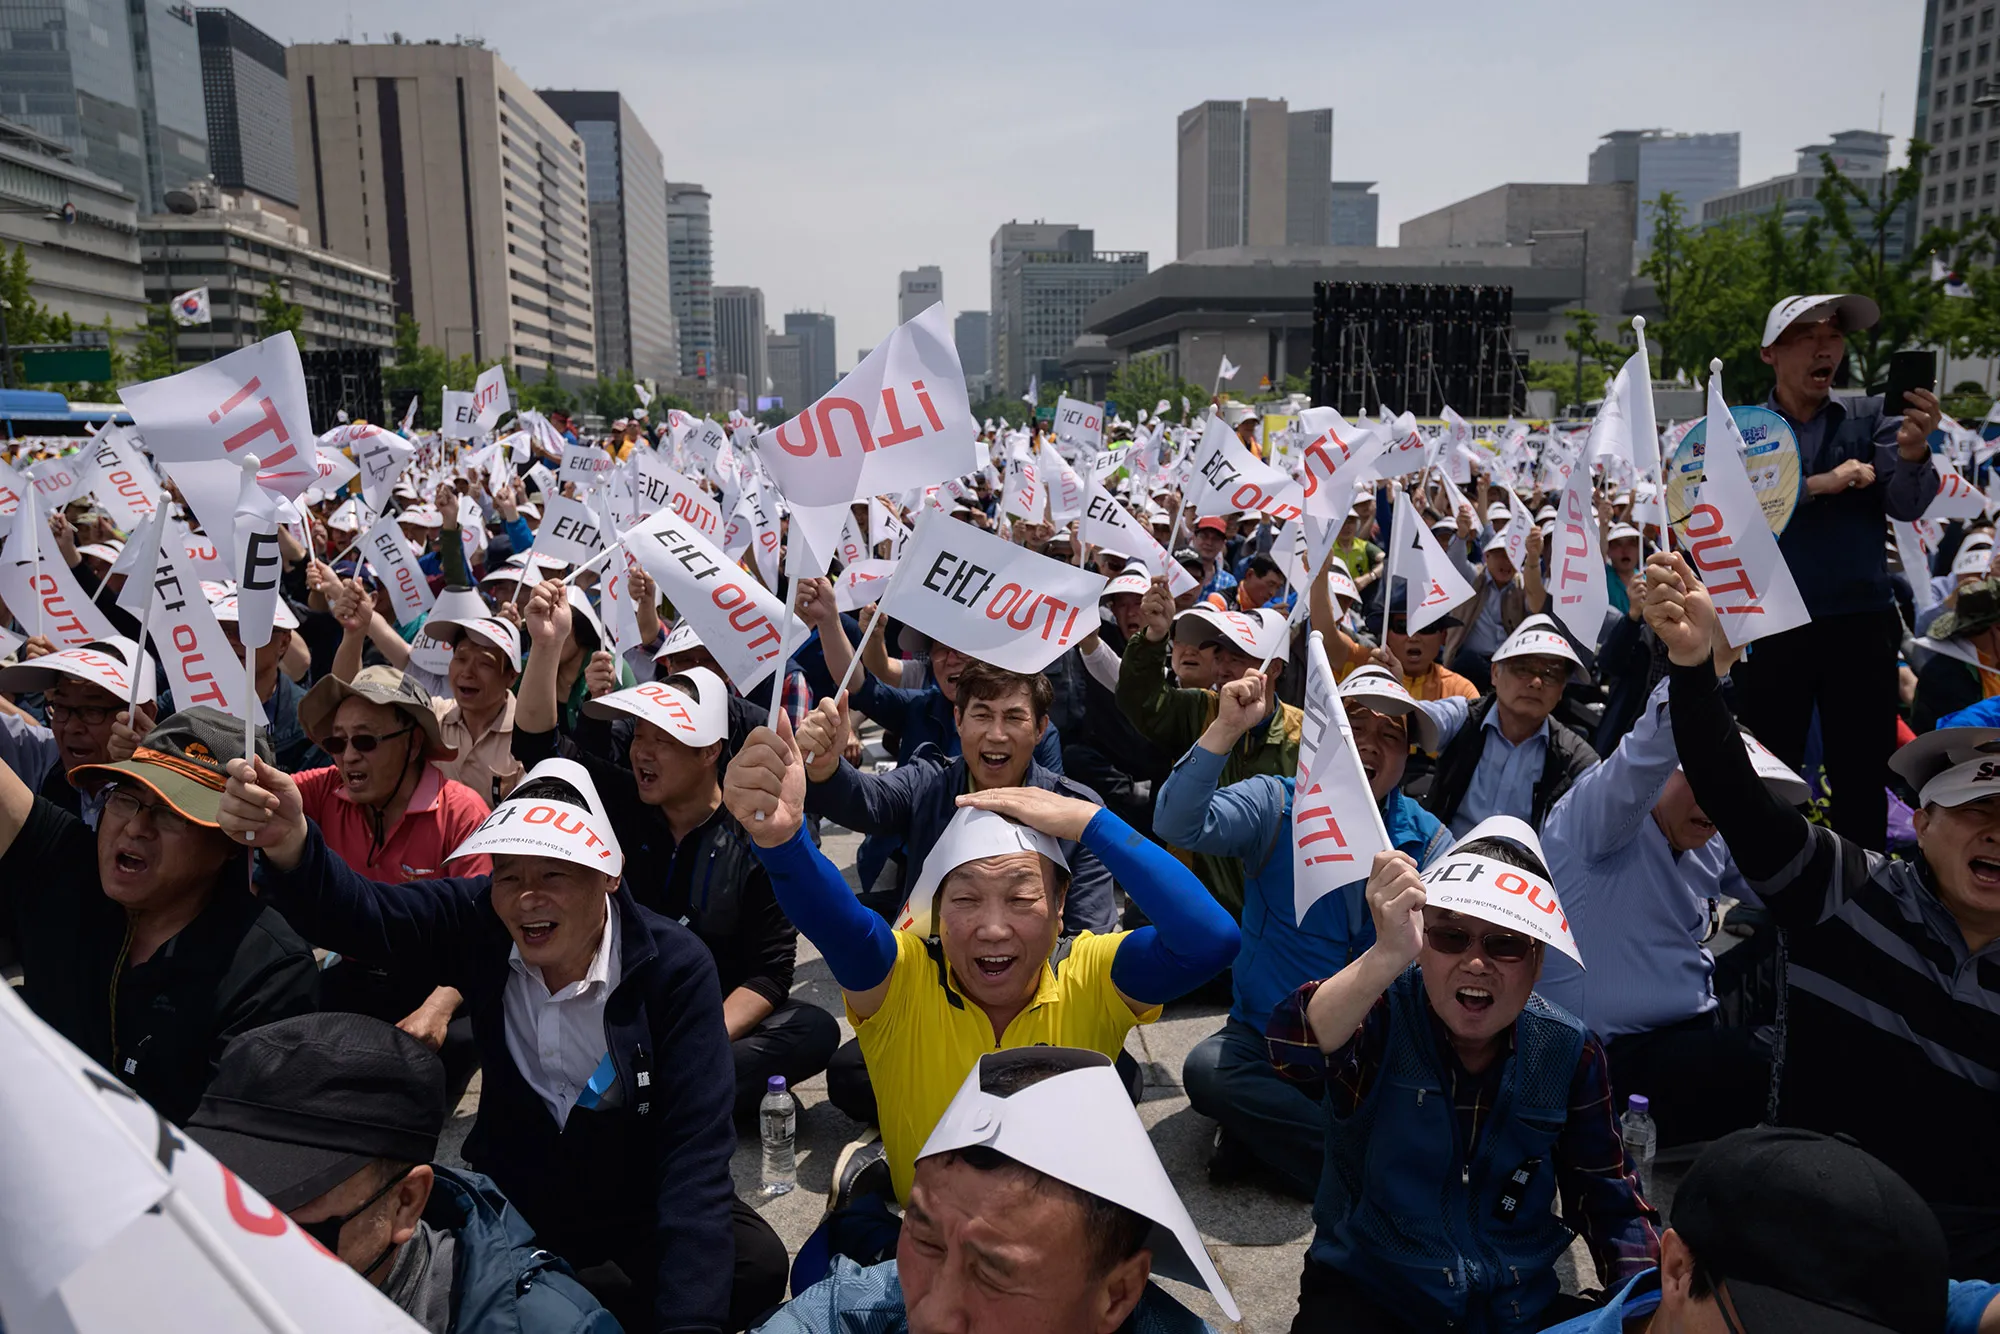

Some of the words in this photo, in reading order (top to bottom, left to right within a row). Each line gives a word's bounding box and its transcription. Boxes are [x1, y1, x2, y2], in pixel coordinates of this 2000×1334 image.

[1084, 416, 1100, 431] OU
[109, 471, 156, 513] OUT!
[1200, 449, 1242, 491] 타다
[1231, 483, 1303, 520] OUT
[1304, 428, 1350, 498] UT!
[552, 516, 602, 548] 타다
[639, 472, 669, 505] 타다
[672, 492, 717, 534] OUT!
[375, 533, 403, 566] 타다
[395, 567, 423, 608] OUT!
[1116, 576, 1149, 588] OUT
[1684, 503, 1765, 615] OUT!
[29, 574, 95, 645] OUT!
[653, 529, 721, 580] 타다
[711, 583, 782, 662] OUT!
[922, 550, 996, 608] 타다
[985, 582, 1080, 646] OUT!
[1226, 612, 1257, 645] UT!
[58, 650, 129, 689] OUT!
[172, 624, 233, 716] OUT
[636, 685, 696, 732] OUT!
[469, 806, 517, 838] 다
[522, 806, 612, 859] OUT!
[1494, 872, 1577, 948] OUT
